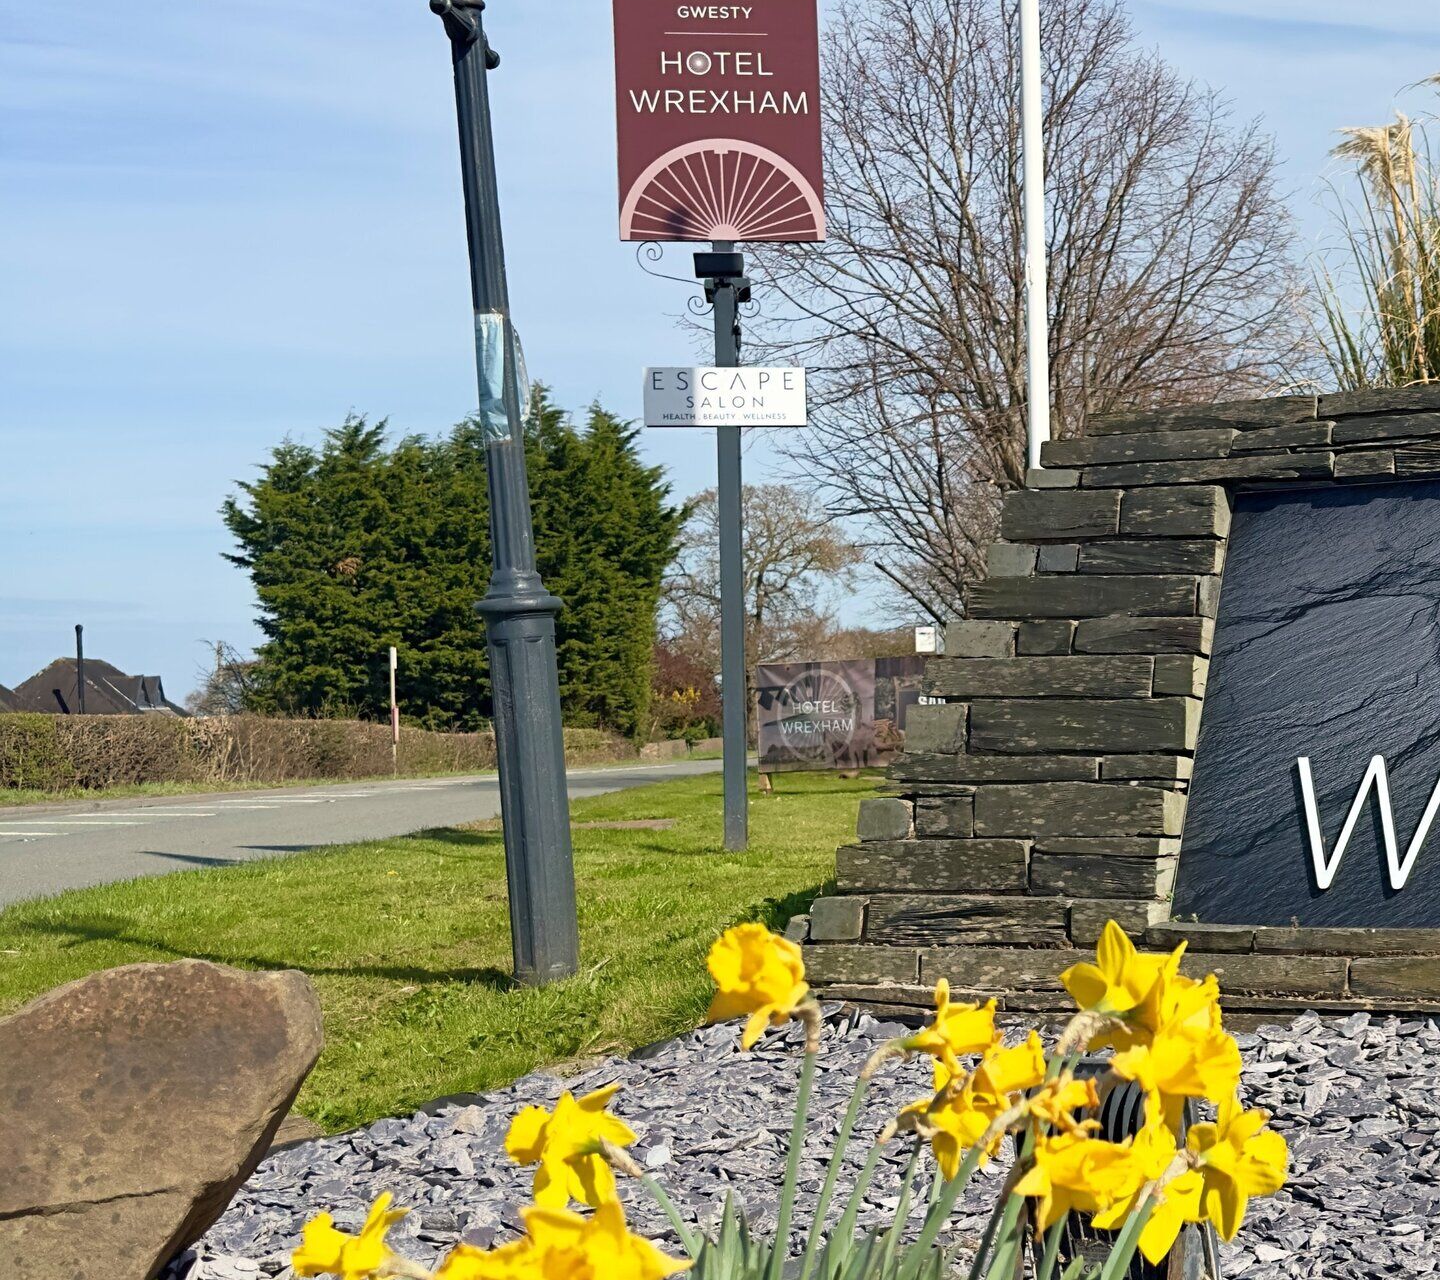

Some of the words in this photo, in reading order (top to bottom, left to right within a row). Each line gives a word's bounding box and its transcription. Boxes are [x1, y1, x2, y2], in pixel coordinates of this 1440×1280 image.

[677, 6, 753, 20] GWESTY
[660, 51, 773, 76] HOTEL
[629, 89, 809, 115] WREXHAM
[652, 371, 794, 391] ESCAPE
[686, 395, 764, 409] SALON
[792, 700, 839, 714] HOTEL
[781, 718, 853, 734] WREXHAM
